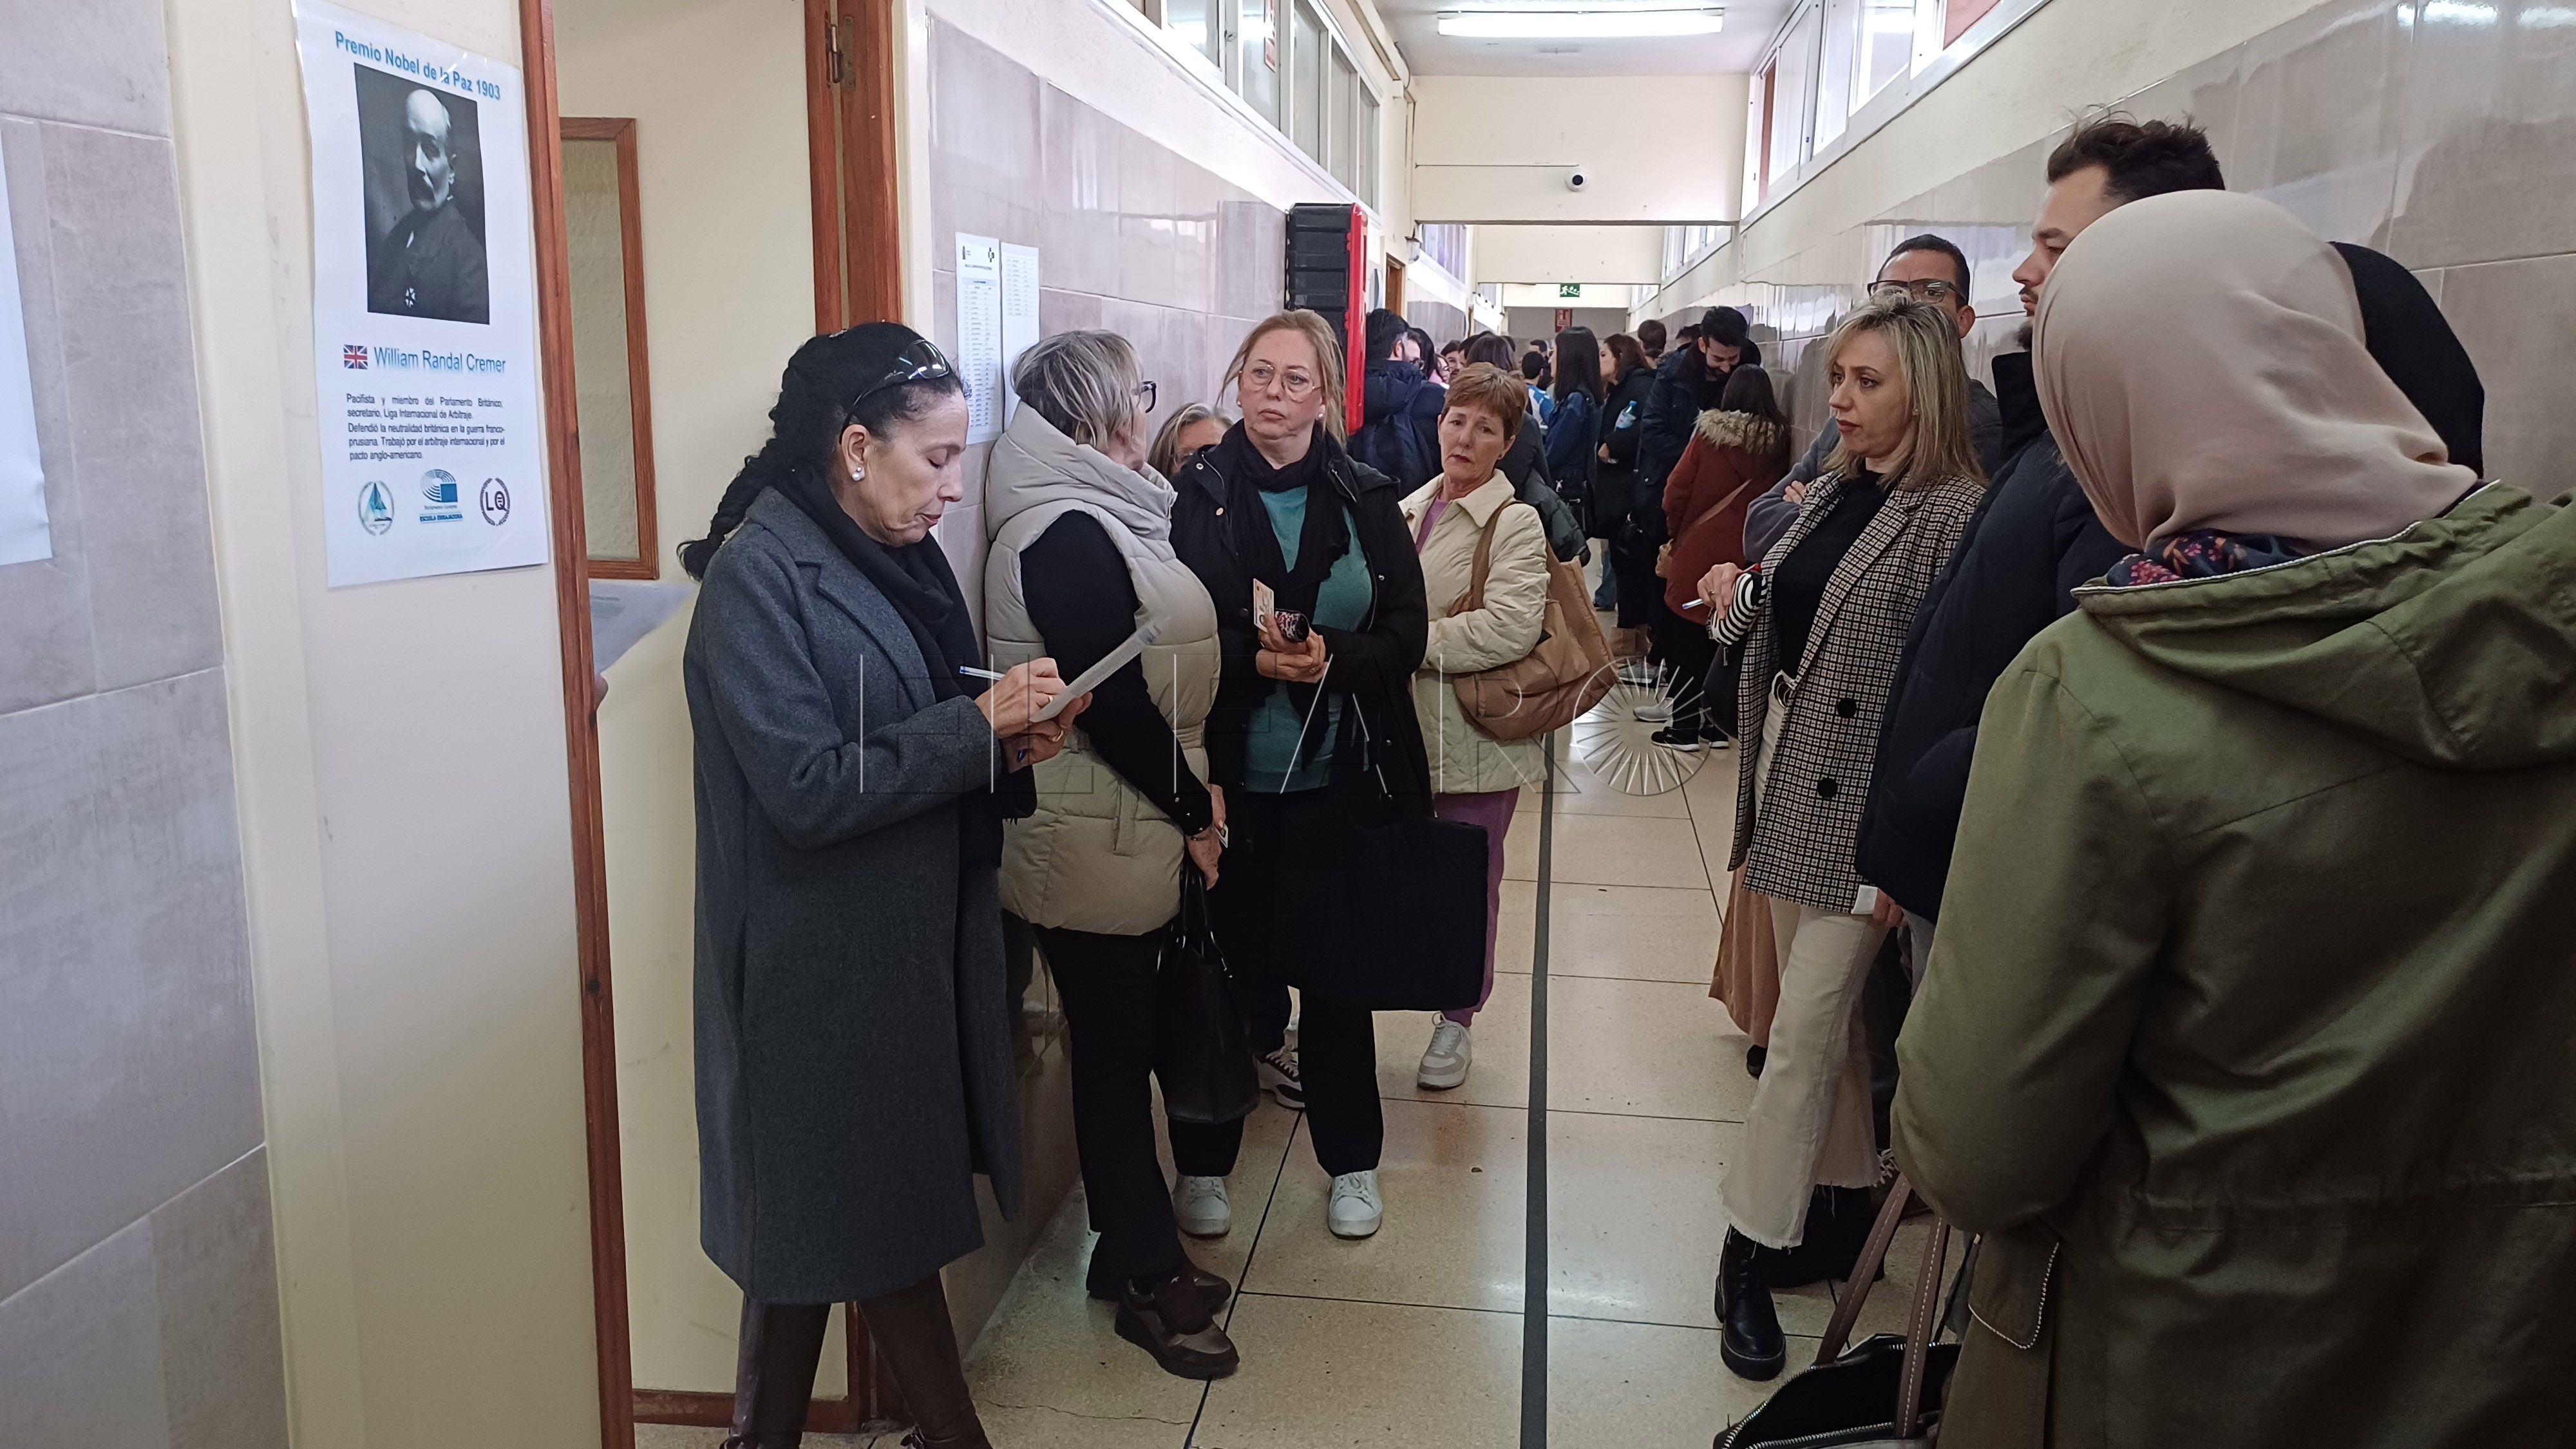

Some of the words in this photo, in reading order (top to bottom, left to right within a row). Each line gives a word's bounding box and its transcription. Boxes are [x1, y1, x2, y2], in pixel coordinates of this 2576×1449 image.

[335, 30, 381, 62] Premio
[385, 48, 420, 75] Nobel
[423, 62, 437, 80] de
[440, 66, 450, 85] la
[453, 70, 473, 92] Paz
[476, 80, 500, 101] 1903
[374, 346, 418, 368] William
[422, 350, 462, 371] Randal
[466, 354, 506, 373] Cremer
[381, 397, 385, 406] y
[392, 395, 419, 405] miembro
[424, 397, 434, 406] del
[384, 408, 398, 420] Liga
[399, 409, 438, 419] Internacional
[439, 410, 447, 419] de
[348, 422, 379, 433] Defendió
[380, 424, 386, 433] la
[388, 423, 423, 433] neutralidad
[459, 424, 465, 433] la
[466, 426, 484, 435] guerra
[486, 424, 505, 434] franco-
[381, 436, 405, 448] Trabajó
[406, 438, 417, 448] por
[417, 437, 424, 446] el
[424, 437, 449, 448] arbitraje
[450, 437, 486, 446] internacional
[486, 439, 489, 448] y
[490, 438, 499, 448] por
[500, 437, 506, 446] el
[349, 451, 368, 462] pacto
